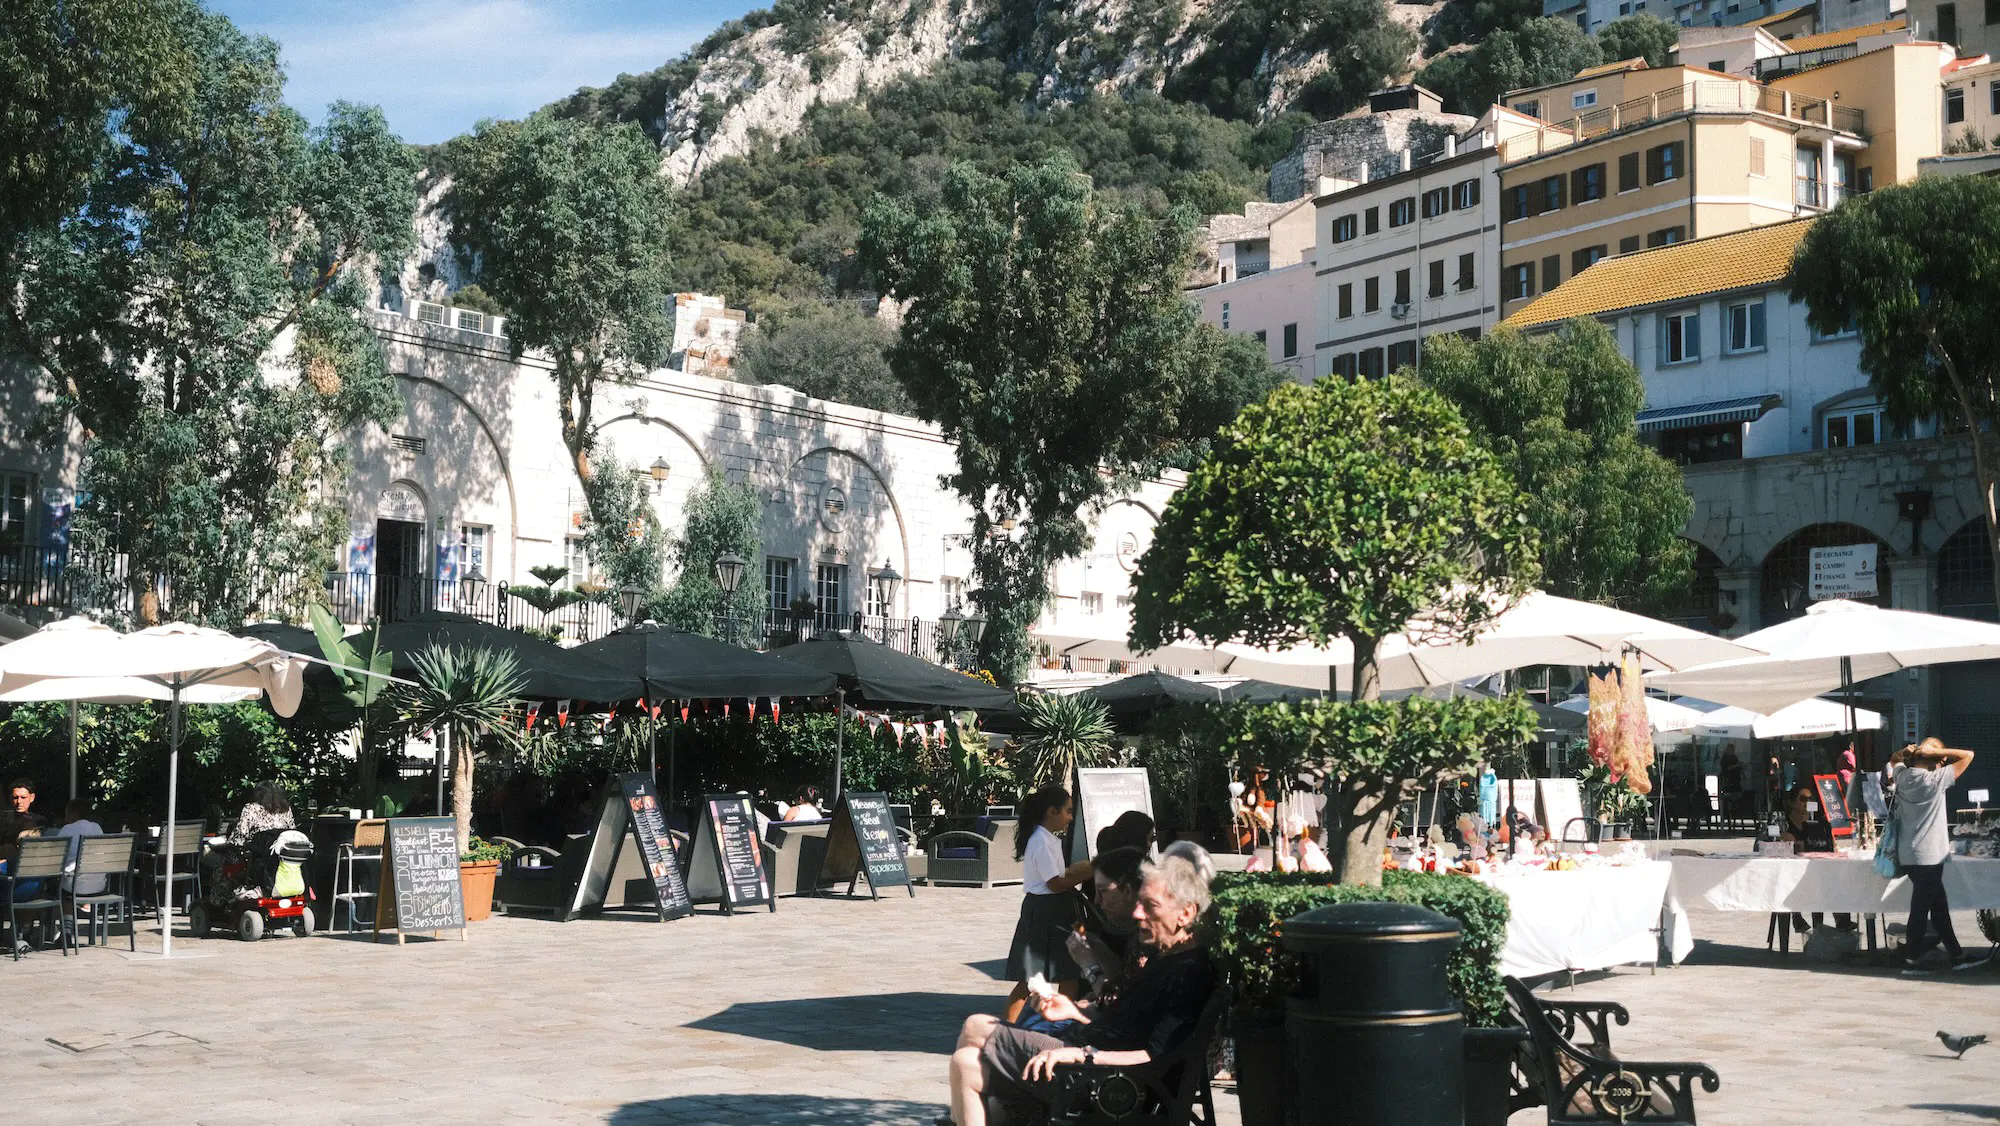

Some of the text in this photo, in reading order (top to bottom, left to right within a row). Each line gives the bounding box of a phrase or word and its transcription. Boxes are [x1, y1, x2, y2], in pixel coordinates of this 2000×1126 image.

[381, 490, 404, 502] Sports
[390, 502, 417, 511] Leisure
[821, 543, 849, 556] Latino's
[1823, 551, 1854, 559] EXCHANGE
[1822, 562, 1846, 570] CAMBIO
[1848, 590, 1871, 598] 71660
[849, 799, 878, 810] Please
[863, 815, 881, 825] seat
[411, 826, 428, 836] WELL
[394, 836, 429, 848] Breakfast
[429, 832, 455, 844] Pub
[430, 842, 457, 854] Food
[409, 853, 457, 869] LUNCH
[868, 863, 905, 876] experience
[395, 855, 416, 929] SALADS
[414, 916, 453, 928] Desserts
[1612, 1088, 1632, 1097] 2008
